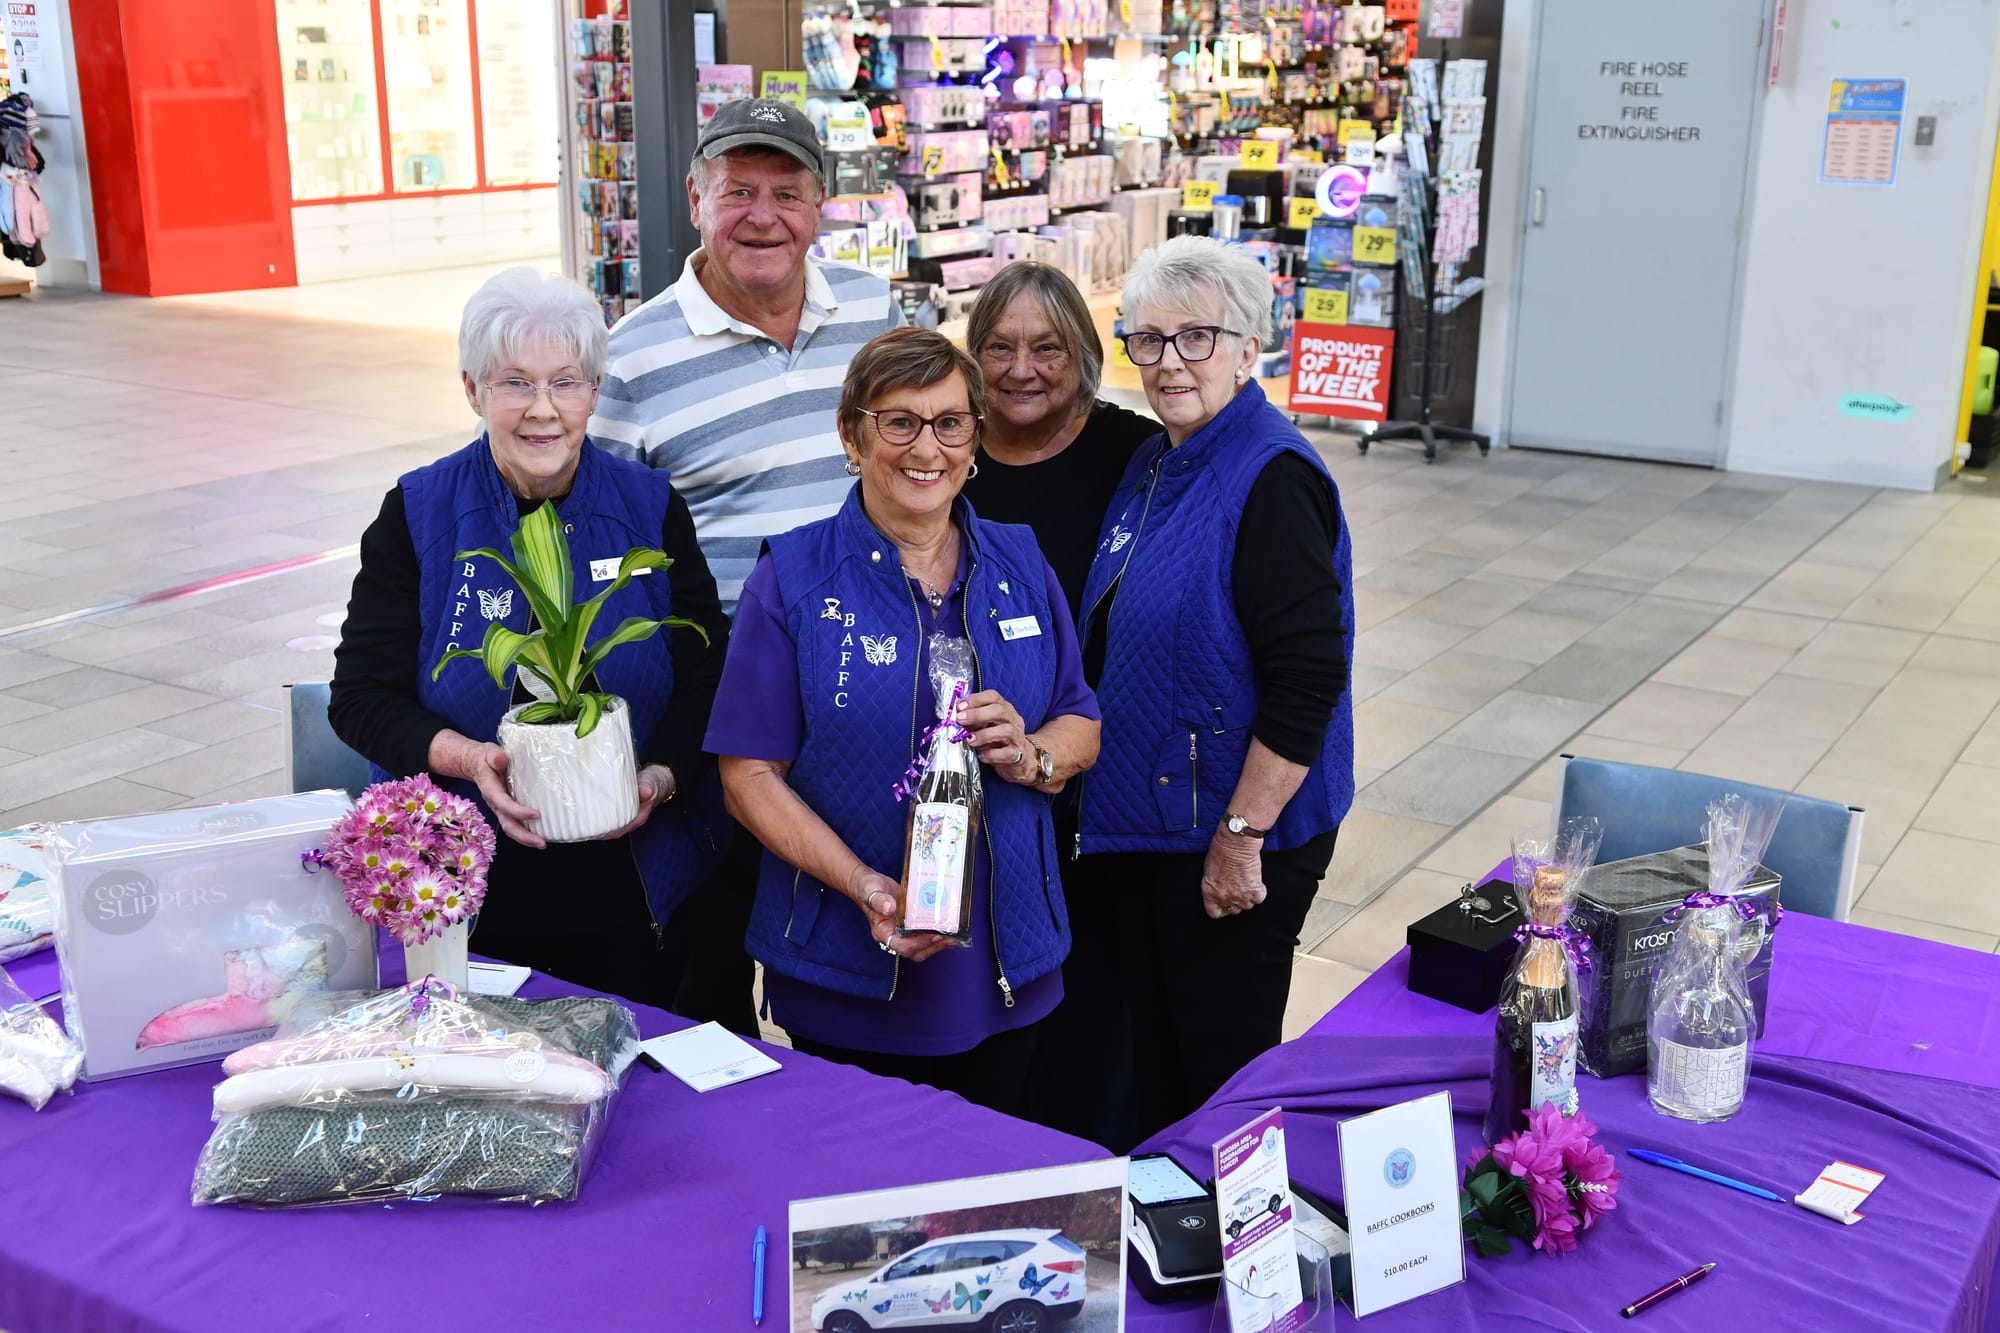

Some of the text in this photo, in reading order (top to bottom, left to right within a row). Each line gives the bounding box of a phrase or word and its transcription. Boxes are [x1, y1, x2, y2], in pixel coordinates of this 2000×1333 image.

[1601, 62, 1689, 77] FIRE HOSE
[1621, 81, 1664, 96] REEL
[1622, 106, 1659, 120] FIRE
[1578, 125, 1701, 141] EXTINGUISHER
[1301, 337, 1384, 359] PRODUCT
[1300, 353, 1381, 378] OF THE
[1298, 370, 1380, 400] WEEK
[95, 880, 150, 901] COSY
[98, 884, 228, 920] SLIPPERS
[1624, 965, 1654, 980] DUET
[1249, 1135, 1259, 1147] FOR
[1220, 1155, 1239, 1173] CANCER
[1367, 1218, 1389, 1234] BAFFC
[1390, 1202, 1435, 1225] COOKBOOKS
[1384, 1255, 1428, 1278] $10.00 EACH
